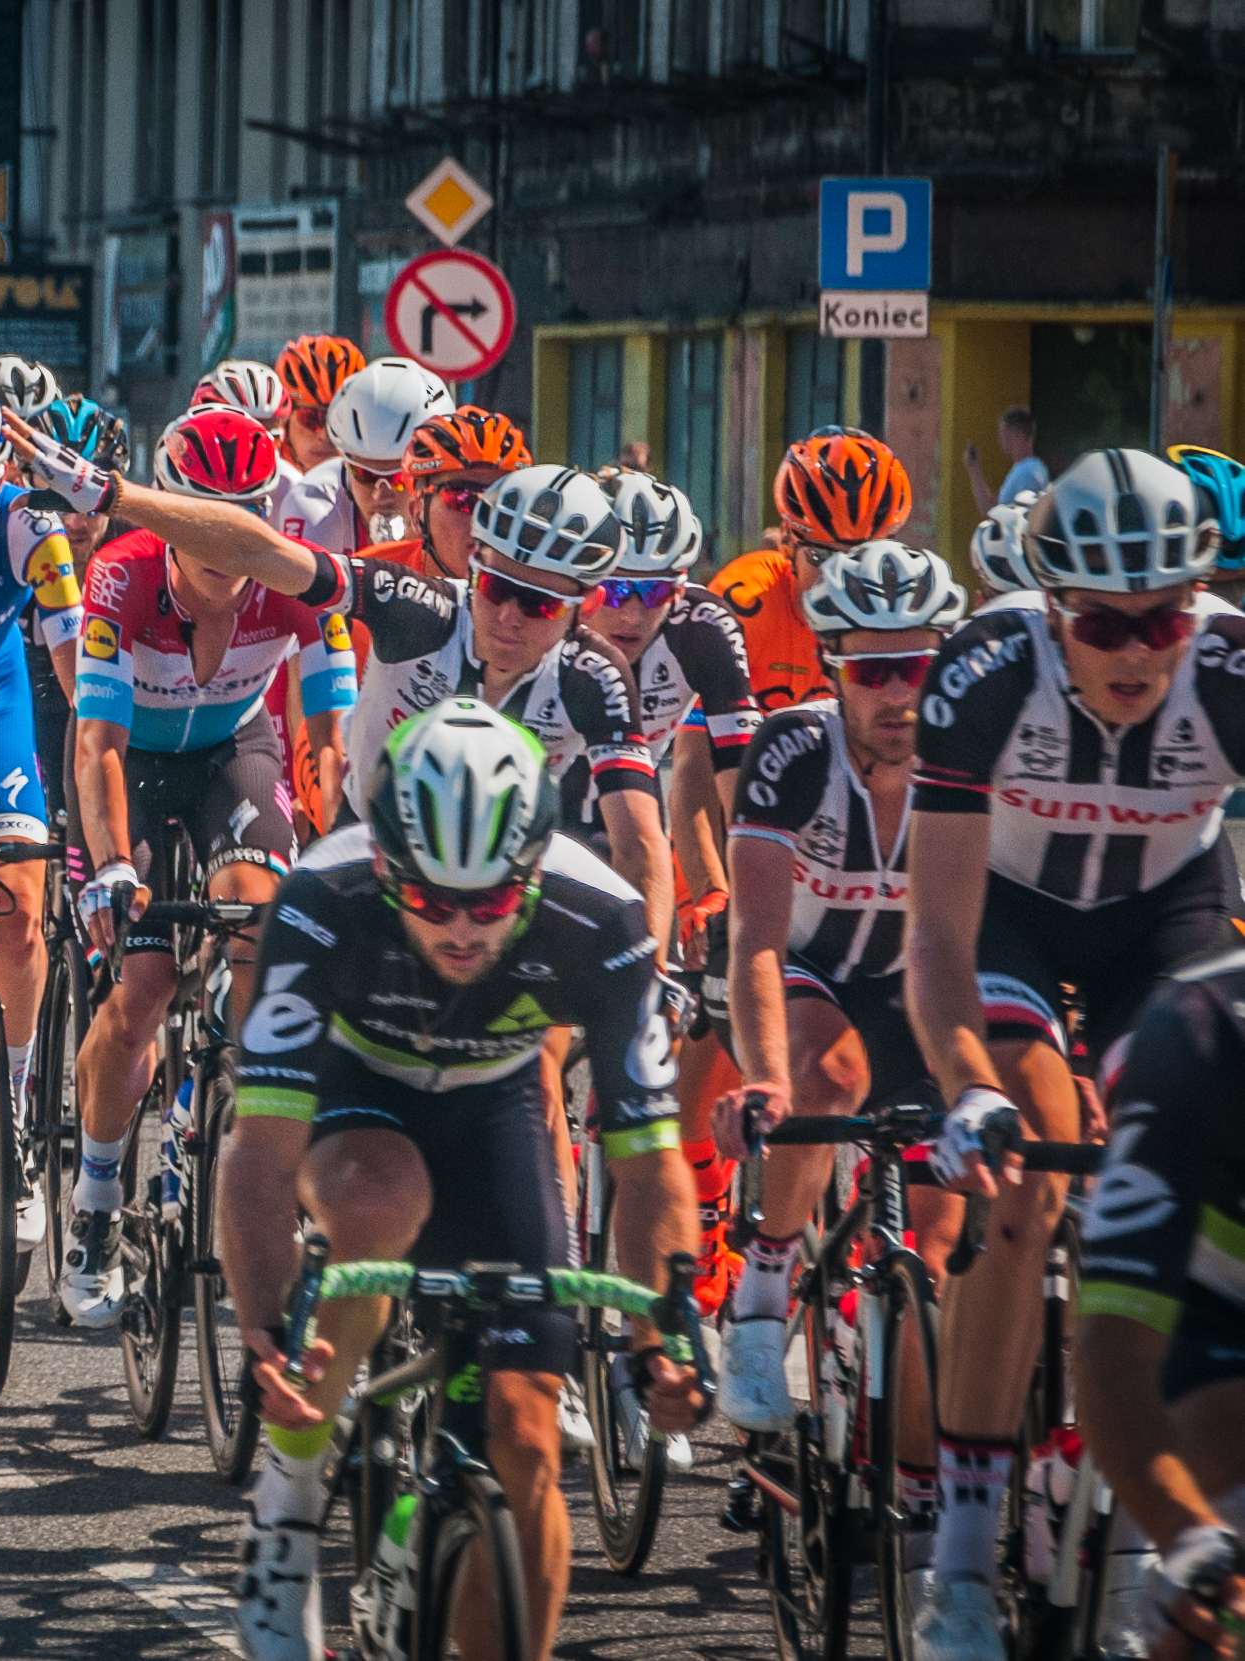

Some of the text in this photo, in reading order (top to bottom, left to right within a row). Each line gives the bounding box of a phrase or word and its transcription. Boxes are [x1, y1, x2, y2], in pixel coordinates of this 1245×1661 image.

[847, 192, 907, 276] P
[824, 300, 923, 328] Koniec
[396, 575, 456, 622] GIANT
[689, 601, 751, 679] GIANT
[939, 631, 1030, 700] GIANT
[574, 649, 632, 724] GIANT
[758, 725, 824, 783] GIANT
[125, 935, 171, 949] texco
